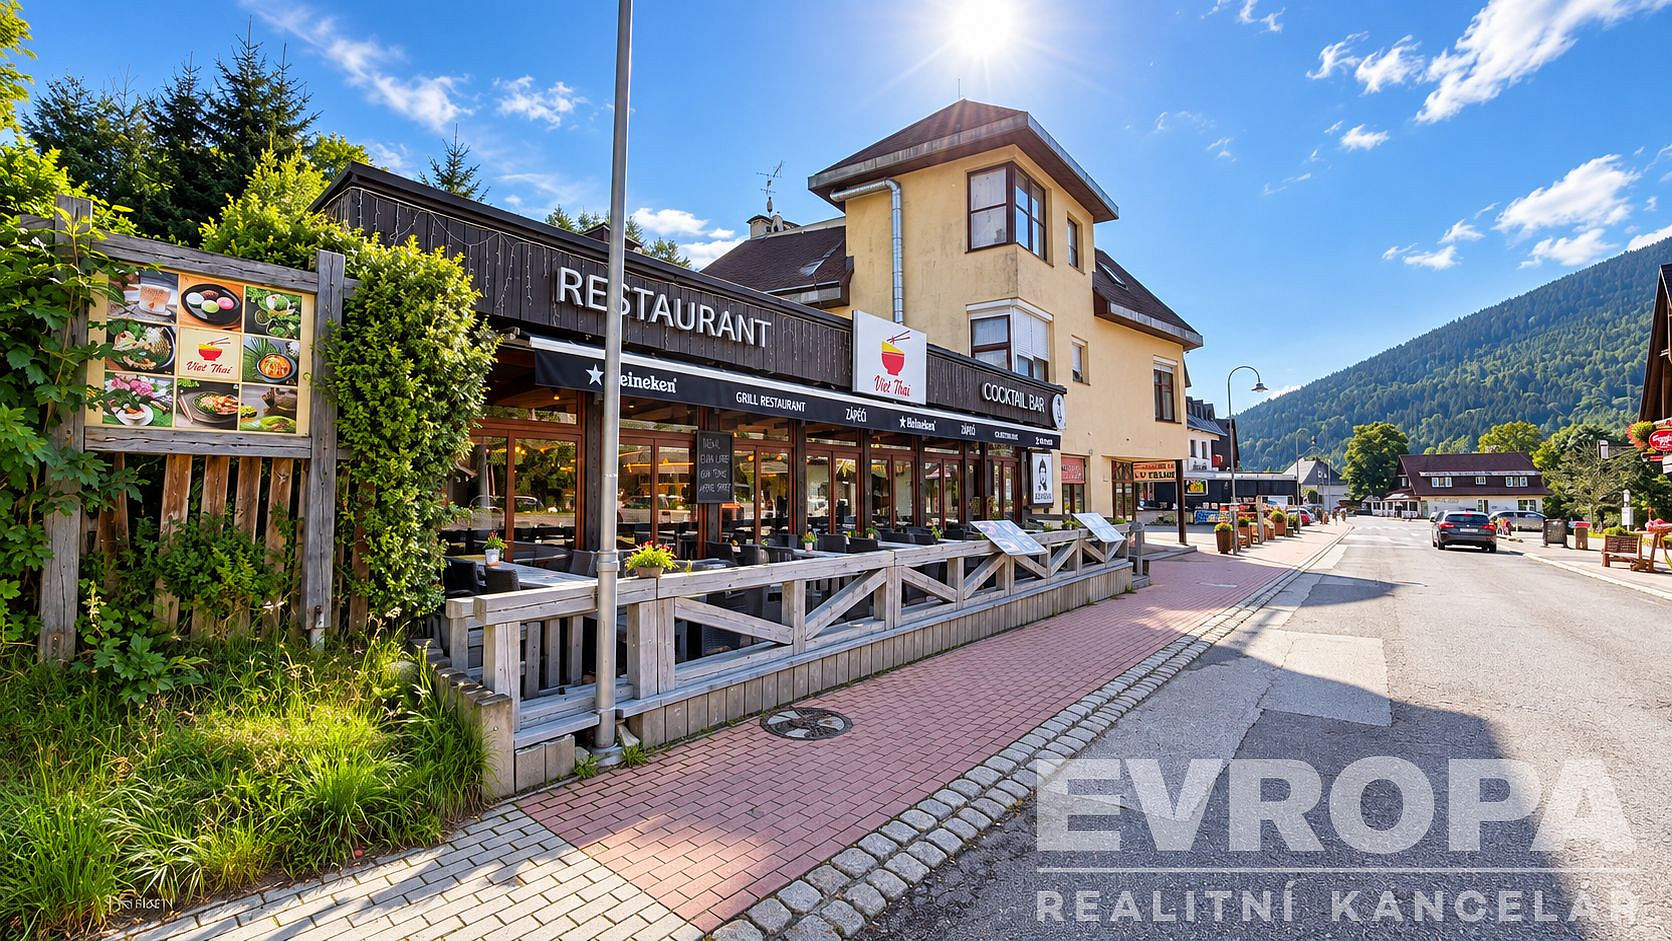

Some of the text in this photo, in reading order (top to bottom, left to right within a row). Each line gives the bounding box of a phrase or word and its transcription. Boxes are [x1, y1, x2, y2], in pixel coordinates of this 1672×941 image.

[211, 363, 232, 374] Thai
[620, 371, 676, 393] eineken
[874, 374, 911, 397] Viet Thai
[736, 391, 806, 412] GRILL RESTAURANT
[981, 382, 1045, 413] COCKTAIL BAR
